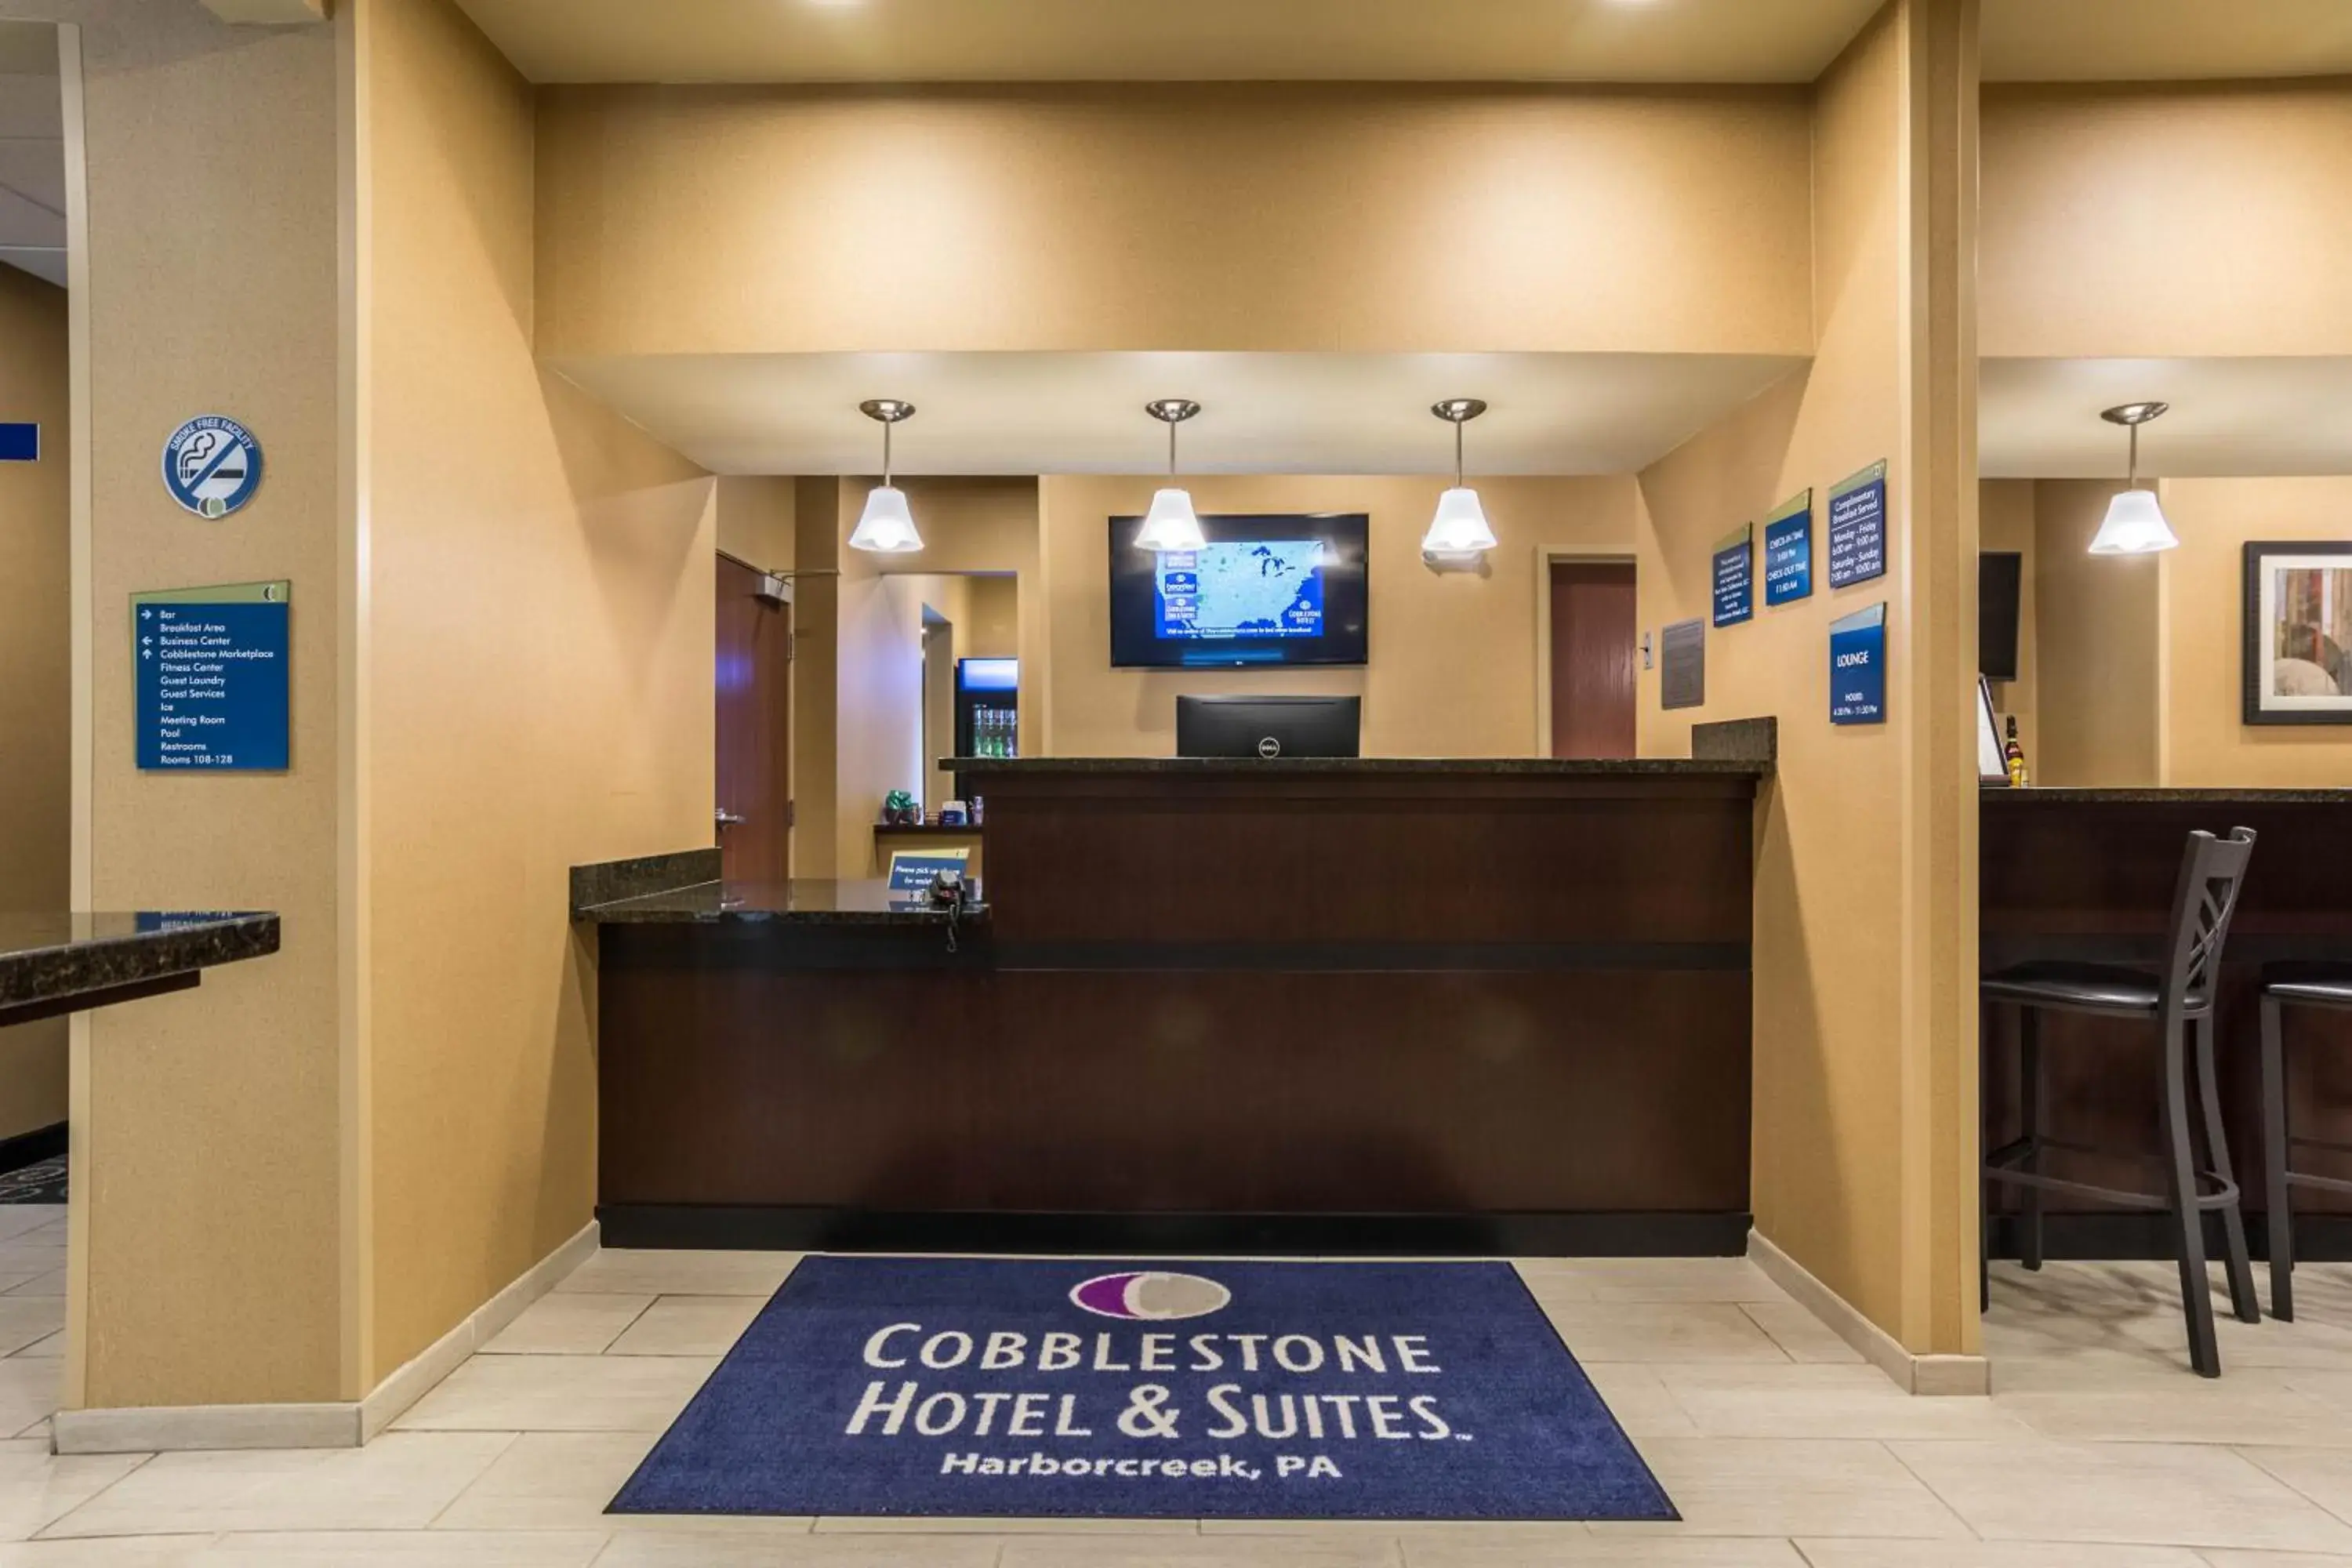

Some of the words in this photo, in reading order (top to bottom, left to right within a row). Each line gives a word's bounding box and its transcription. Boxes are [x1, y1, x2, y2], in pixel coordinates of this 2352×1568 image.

[171, 423, 195, 451] SMOKE
[197, 418, 220, 430] FREE
[221, 420, 254, 450] FACILITY
[1835, 488, 1875, 512] Complimentary
[1832, 509, 1857, 524] Breakfast
[1858, 499, 1878, 514] Served
[1835, 530, 1855, 543] Monday
[1860, 522, 1876, 534] Friday
[1869, 534, 1879, 543] am
[1832, 556, 1854, 571] Saturday
[1858, 547, 1879, 562] Sunday
[1767, 568, 1784, 582] CHECK
[1843, 570, 1851, 579] am
[1871, 561, 1882, 570] am
[160, 623, 201, 632] Breakfast
[203, 623, 226, 632] Area
[160, 637, 198, 645] Business
[200, 637, 231, 645] Center
[160, 649, 216, 659] Cobblestone
[219, 649, 274, 660] Marketplace
[1837, 650, 1869, 667] LOUNGE
[160, 662, 191, 672] Fitness
[193, 662, 224, 672] Center
[160, 676, 187, 684] Guest
[189, 675, 226, 686] Laundry
[160, 689, 187, 699] Guest
[189, 689, 225, 699] Services
[161, 702, 174, 711] Ice
[161, 715, 197, 726] Meeting
[200, 715, 225, 724] Room
[161, 728, 180, 737] Pool
[161, 742, 206, 751] Restrooms
[161, 755, 191, 764] Rooms
[194, 755, 233, 764] 108-128
[863, 1323, 1442, 1372] COBBLESTONE
[845, 1381, 1092, 1436] HOTEL
[1117, 1384, 1180, 1438] &
[1207, 1384, 1451, 1440] SUITES
[941, 1452, 1261, 1480] Harborcreek,
[1276, 1456, 1343, 1478] PA
